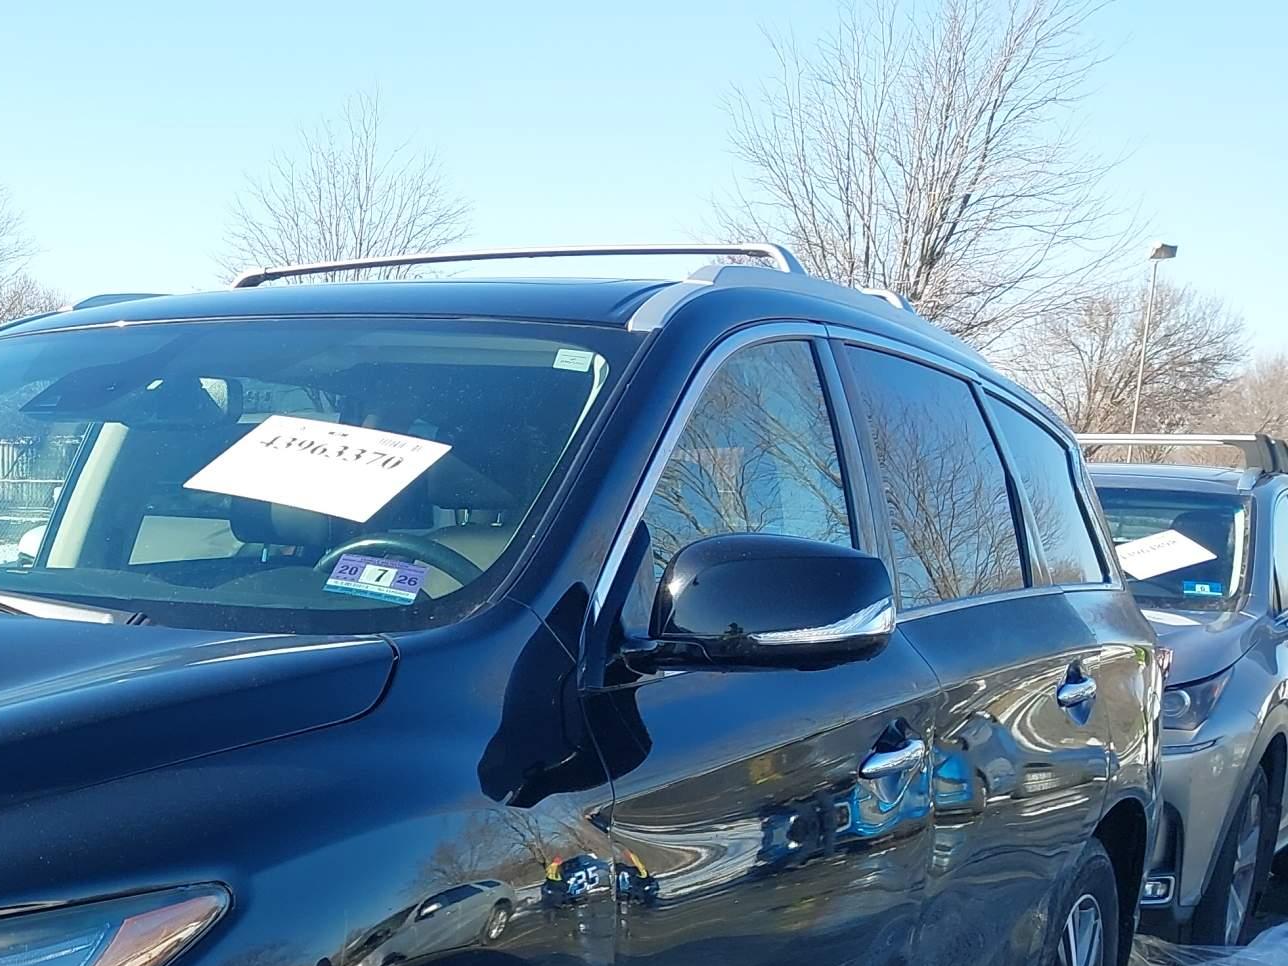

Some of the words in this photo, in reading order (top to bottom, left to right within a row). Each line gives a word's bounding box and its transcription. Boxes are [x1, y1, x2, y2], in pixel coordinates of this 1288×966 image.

[338, 565, 359, 576] 20
[375, 568, 389, 582] 7
[397, 575, 419, 587] 26
